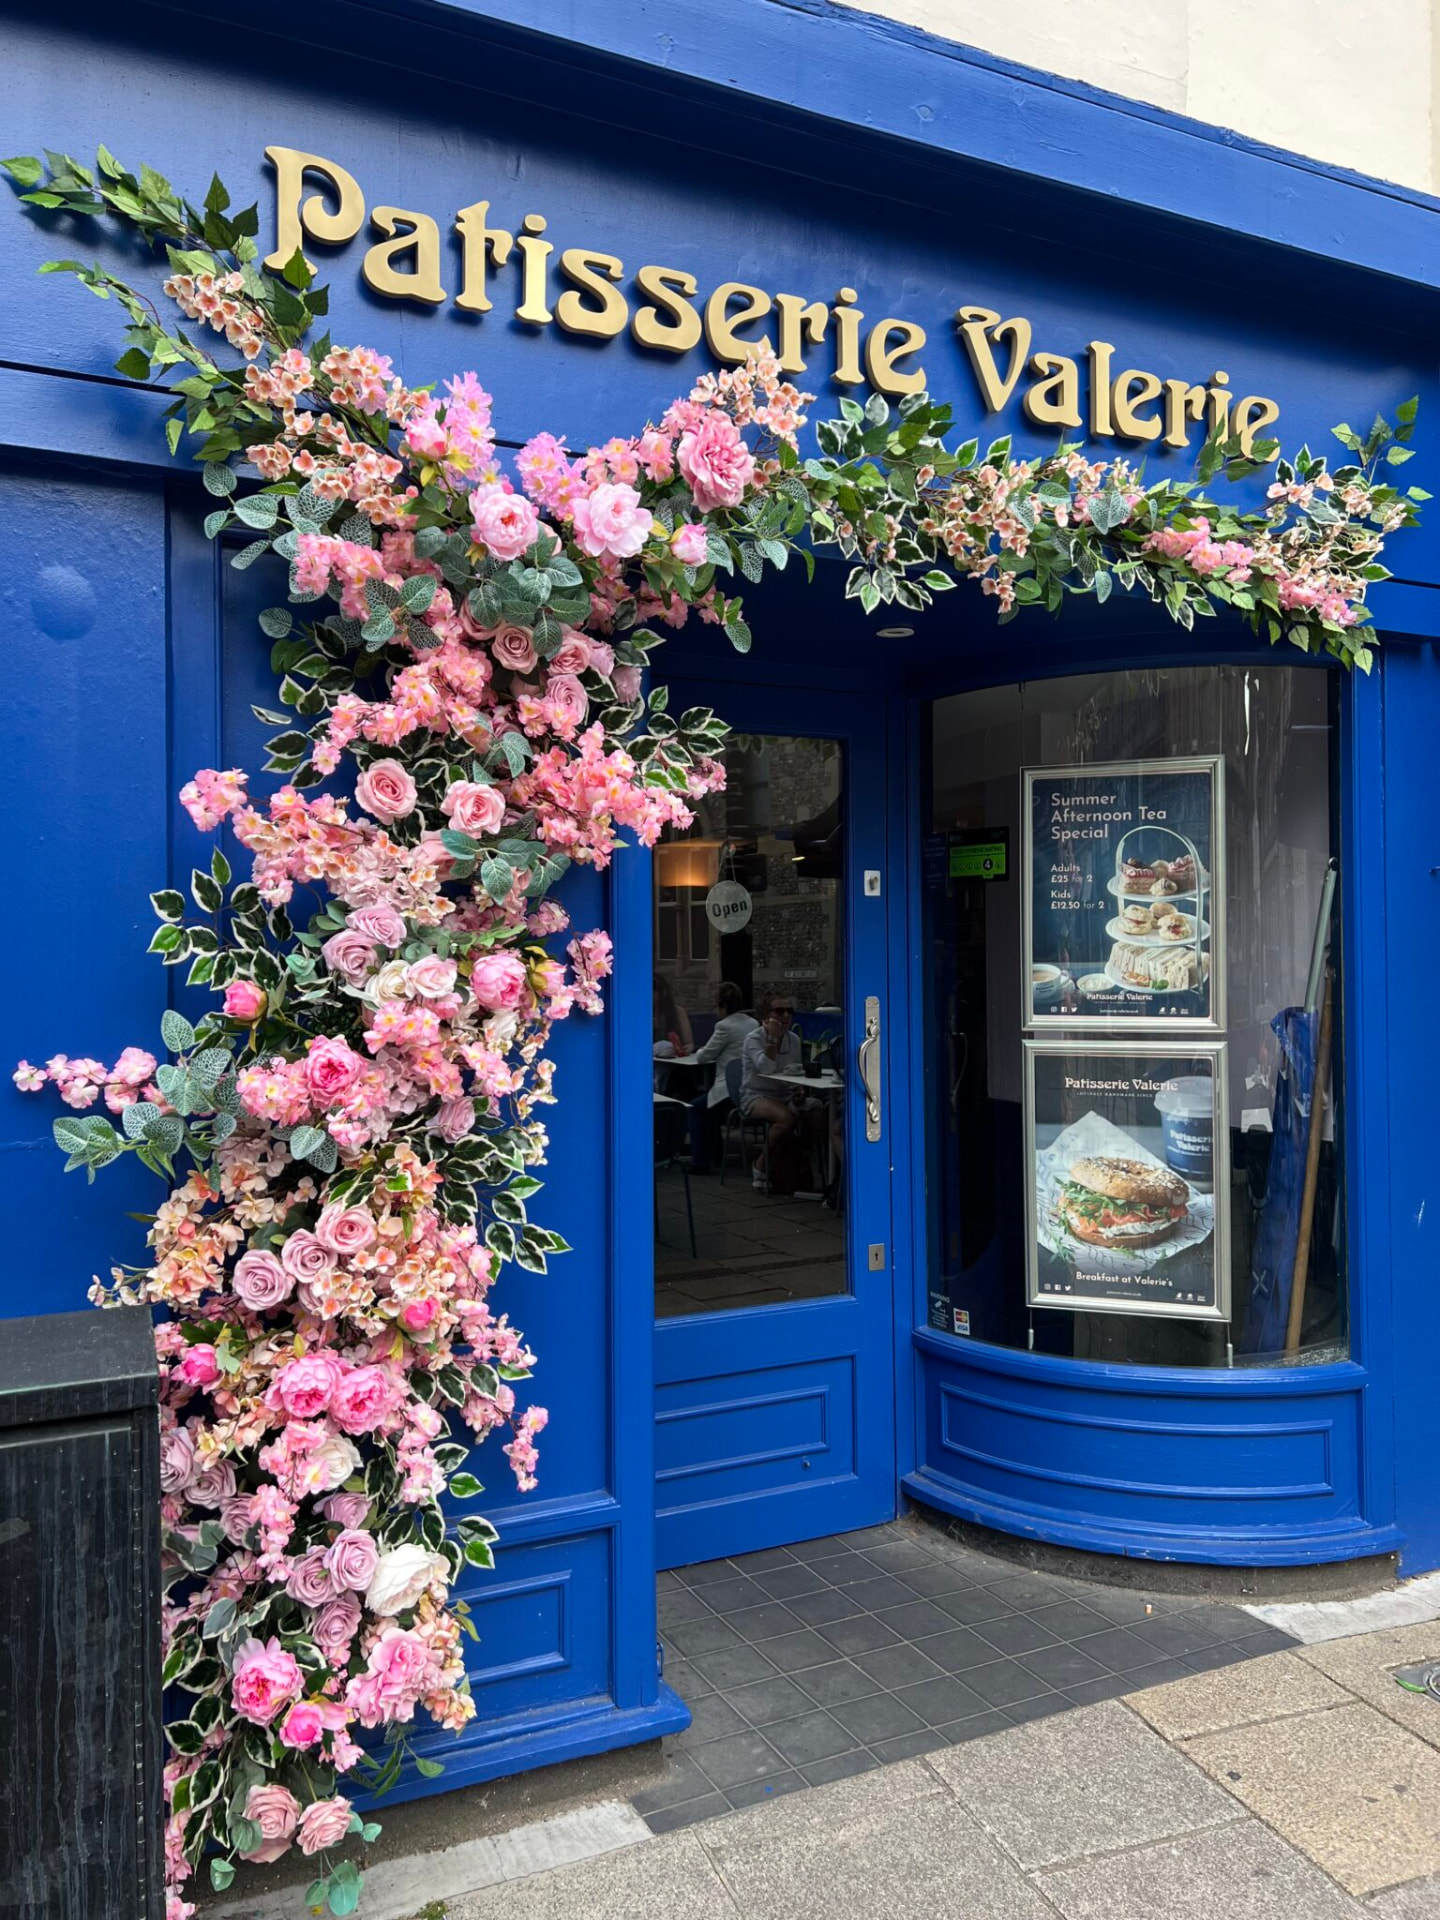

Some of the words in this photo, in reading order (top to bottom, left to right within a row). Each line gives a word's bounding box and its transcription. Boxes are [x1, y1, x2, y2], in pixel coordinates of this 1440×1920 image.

[263, 146, 927, 394] Patisserie
[955, 305, 1280, 463] Valerie
[1051, 792, 1117, 807] Summer
[1051, 808, 1132, 823] Afternoon
[1138, 806, 1167, 820] Tea
[1051, 823, 1108, 842] Special
[984, 859, 991, 869] 4
[1050, 863, 1081, 872] Adults
[1050, 874, 1069, 883] £25
[1086, 874, 1093, 882] 2
[1050, 889, 1072, 899] Kids
[711, 900, 748, 919] Open
[1083, 900, 1096, 909] for
[1098, 901, 1105, 909] 2
[1064, 1077, 1130, 1090] Patisserie
[1132, 1078, 1179, 1091] Valerie
[1170, 1129, 1212, 1144] Patisseri
[1076, 1271, 1120, 1283] Breakfast
[1121, 1275, 1132, 1284] at
[1134, 1275, 1173, 1287] Valerie's
[957, 1323, 968, 1331] VISA
